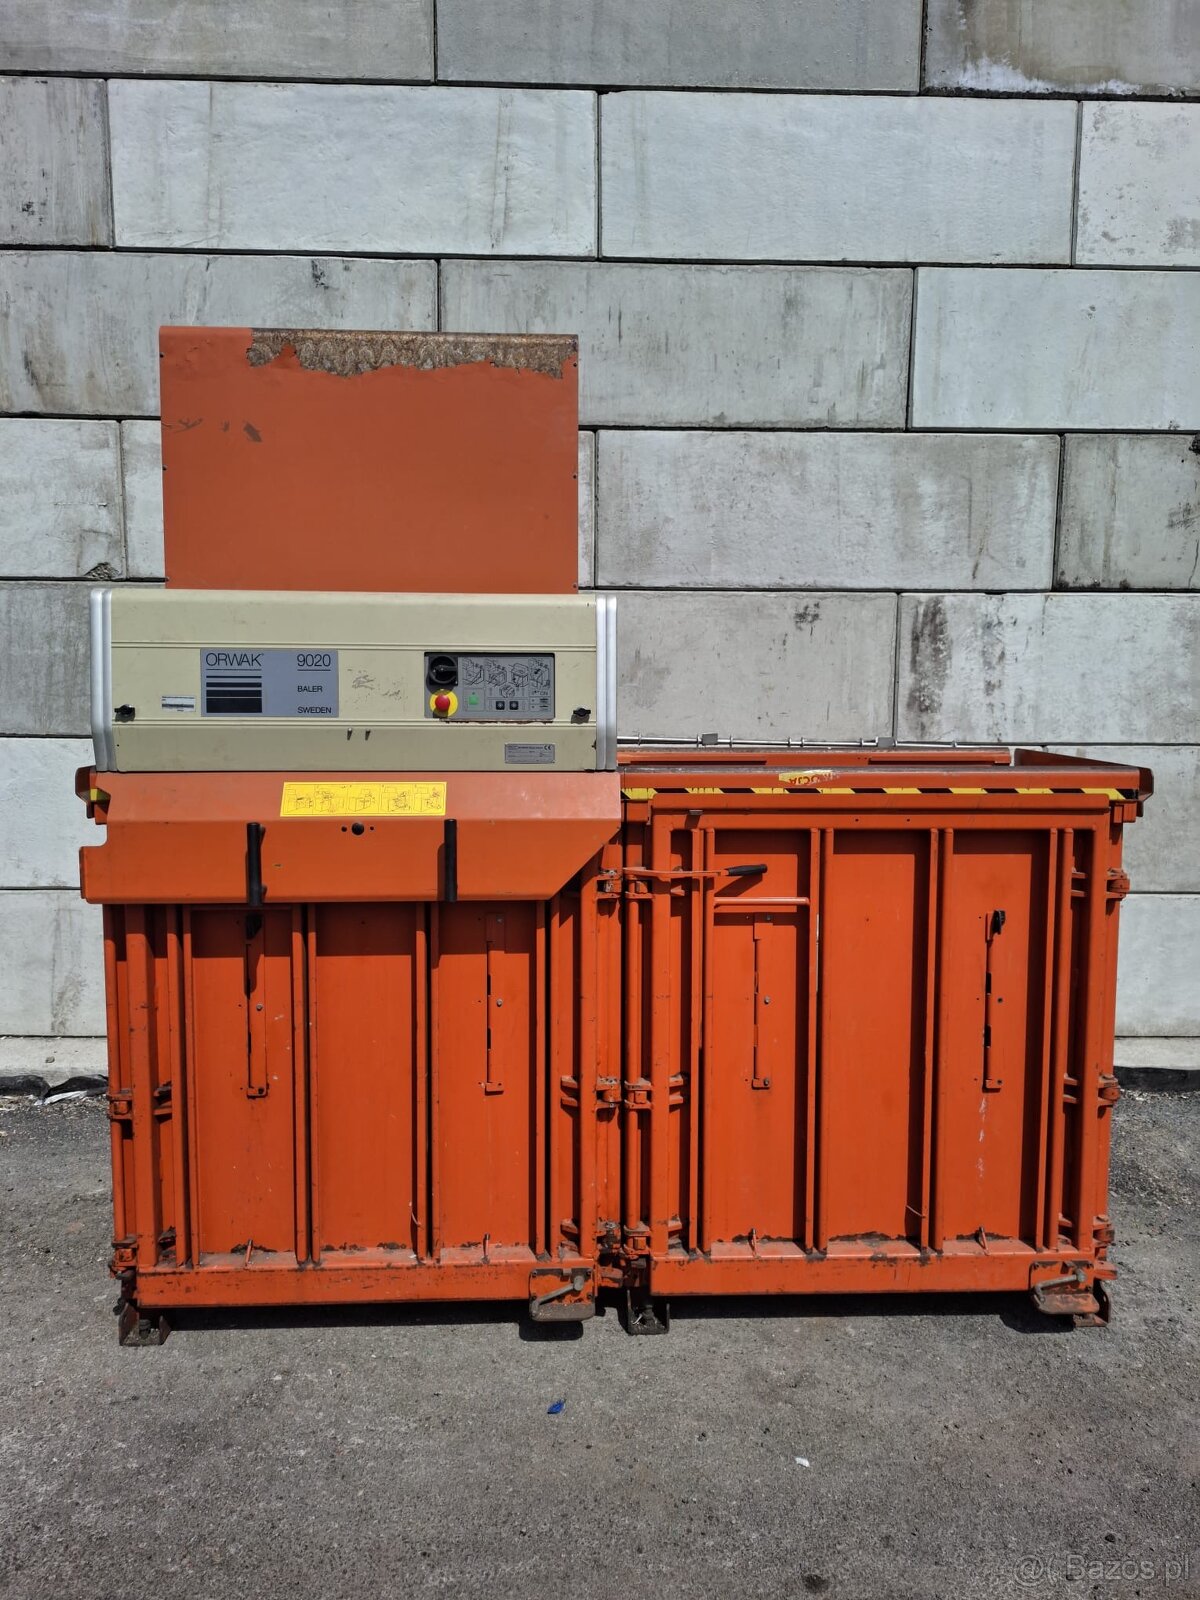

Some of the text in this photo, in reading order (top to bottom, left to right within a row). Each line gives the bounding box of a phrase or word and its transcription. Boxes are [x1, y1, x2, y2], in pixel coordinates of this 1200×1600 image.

[205, 652, 262, 667] ORWAK
[296, 653, 331, 667] 9020
[297, 685, 323, 693] BALER
[297, 706, 332, 714] SWEDEN
